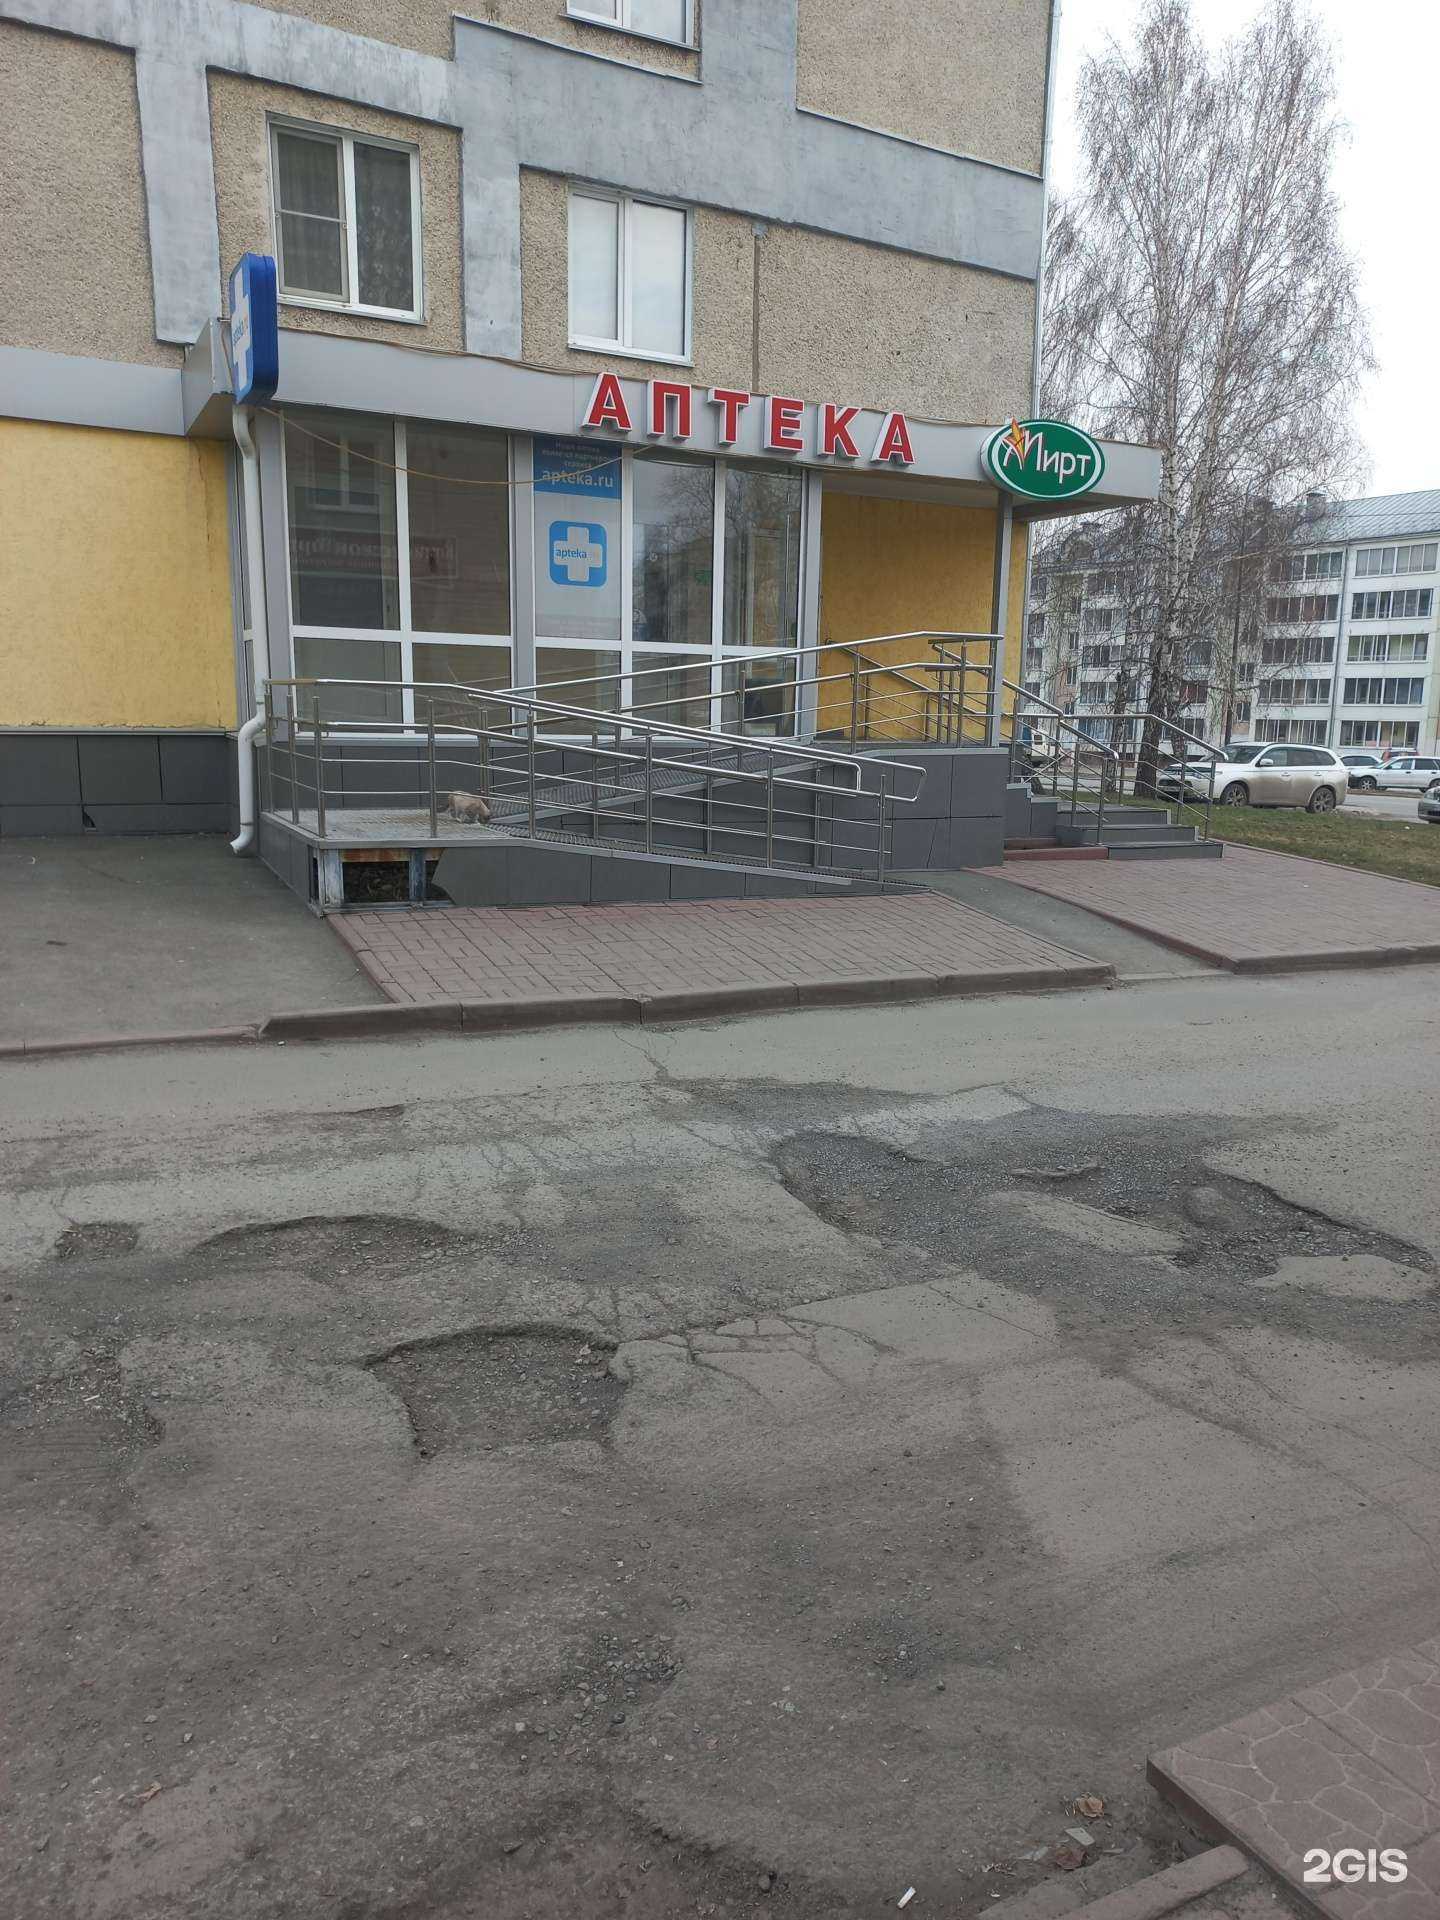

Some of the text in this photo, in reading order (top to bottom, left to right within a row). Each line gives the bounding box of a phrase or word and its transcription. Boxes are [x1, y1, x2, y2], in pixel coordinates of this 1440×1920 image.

[582, 372, 916, 465] АПТЕКА
[1000, 418, 1091, 484] Мирт
[542, 469, 614, 488] apteka.ru
